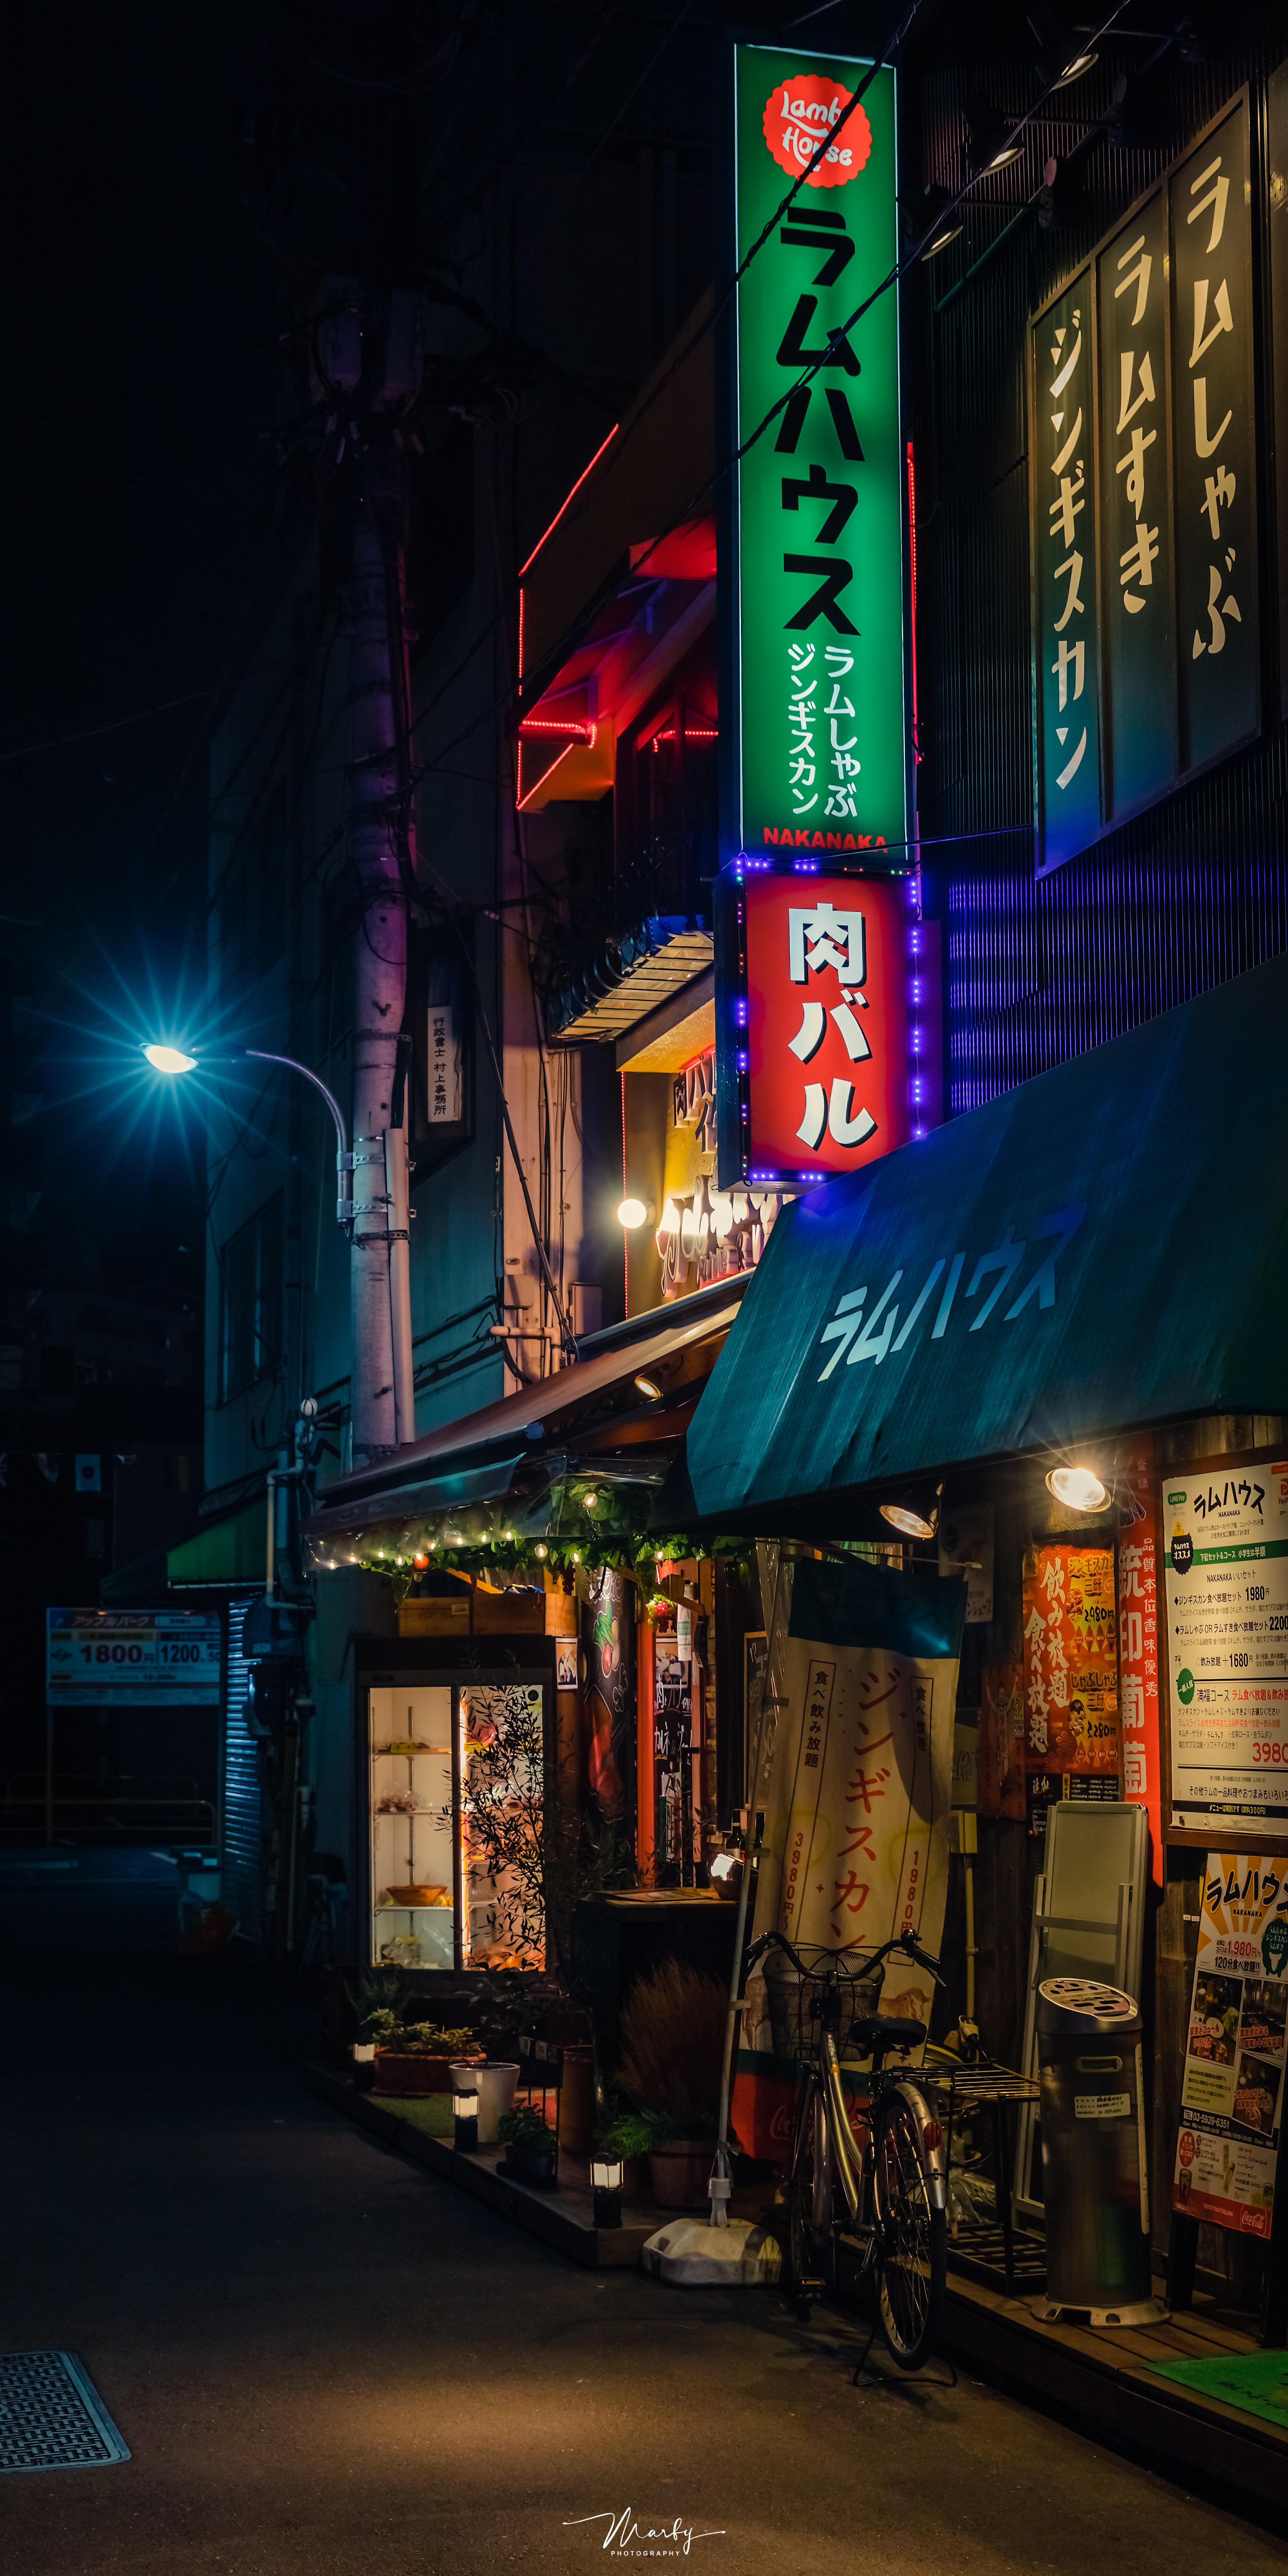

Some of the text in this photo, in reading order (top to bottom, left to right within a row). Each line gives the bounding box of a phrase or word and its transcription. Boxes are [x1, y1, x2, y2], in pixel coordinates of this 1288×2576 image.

[780, 91, 842, 138] Lamb
[774, 207, 865, 636] ラムハウス
[1115, 235, 1159, 615] ラムすき
[1187, 155, 1242, 660] ラムしゃぶ
[1049, 308, 1087, 790] ジンギスカン
[788, 643, 818, 814] ジンギスカン
[824, 646, 861, 817] ラムしゃぶ
[764, 827, 888, 853] NAKANAKA
[433, 1017, 446, 1116] 行政書士 村上事務所
[788, 903, 877, 1150] 肉バル
[817, 1202, 1087, 1382] ラムハウス
[1193, 1479, 1265, 1519] ラムハウス
[1173, 1550, 1191, 1560] オススメ
[1179, 1585, 1270, 1605] ジンギスカン食べ放題セット 1980円
[1207, 1573, 1232, 1583] NAKANAKA
[1040, 1557, 1070, 1709] 飲み放題
[1141, 1537, 1159, 1698] 品質本位香味優秀
[1180, 1625, 1203, 1635] ラムしゃぶ
[1205, 1624, 1212, 1633] OR
[1214, 1620, 1268, 1633] ラムすき食べ放題セット
[1200, 1656, 1221, 1667] 飲み放題
[804, 1670, 829, 1768] 食べ飲み放題
[916, 1686, 927, 1752] 食べ放題
[1024, 1606, 1050, 1754] 食べ放題
[1197, 1689, 1229, 1702] 満福コース
[830, 1667, 900, 1953] ジンギスカン
[1233, 1908, 1262, 1918] NAKANAKA
[1193, 2112, 1229, 2129] 03-5939-6351
[1241, 2211, 1264, 2229] Coca-Cola
